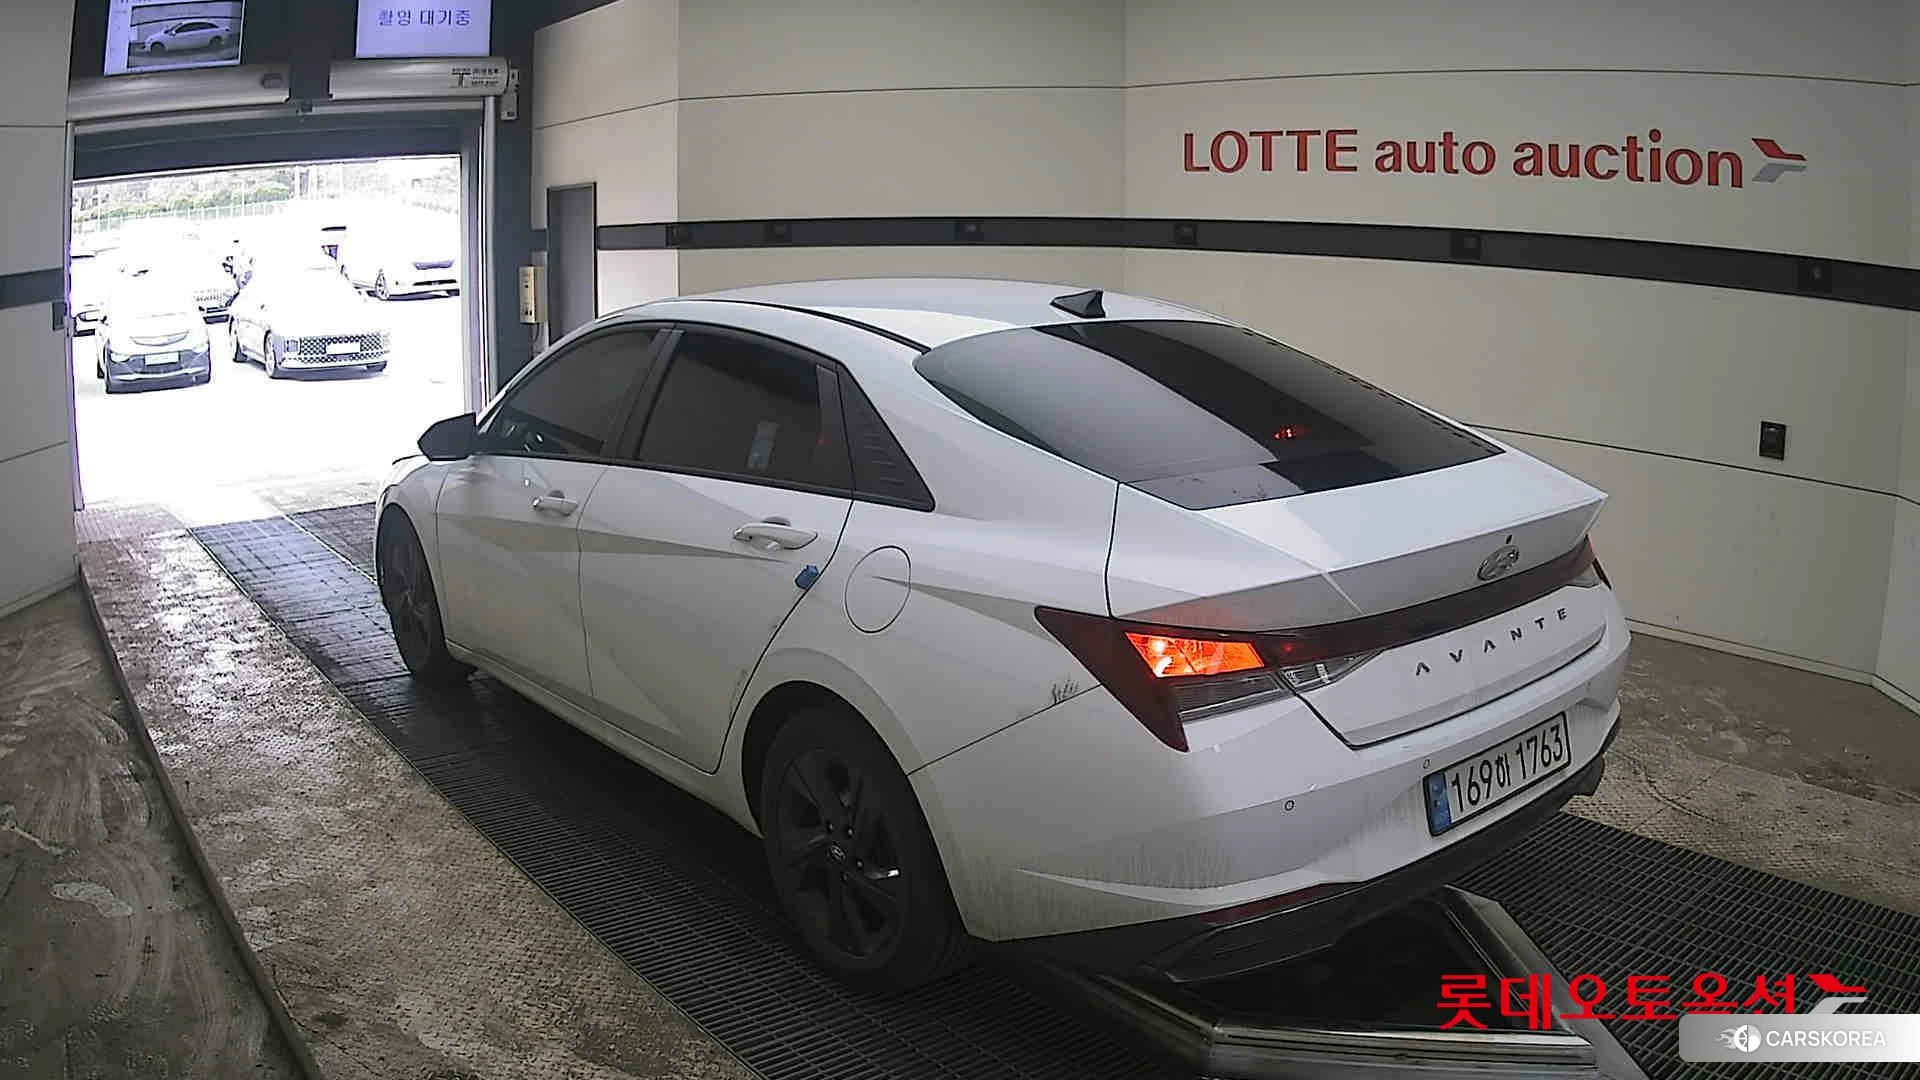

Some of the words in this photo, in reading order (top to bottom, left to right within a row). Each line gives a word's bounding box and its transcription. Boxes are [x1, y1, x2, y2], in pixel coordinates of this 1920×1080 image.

[420, 9, 470, 26] 대기중
[1184, 129, 1358, 173] LOTTE
[1375, 131, 1496, 175] auto
[1512, 128, 1743, 188] auction
[1415, 607, 1567, 677] AVANTE
[1451, 752, 1511, 812] 169하
[1516, 724, 1563, 779] 1763
